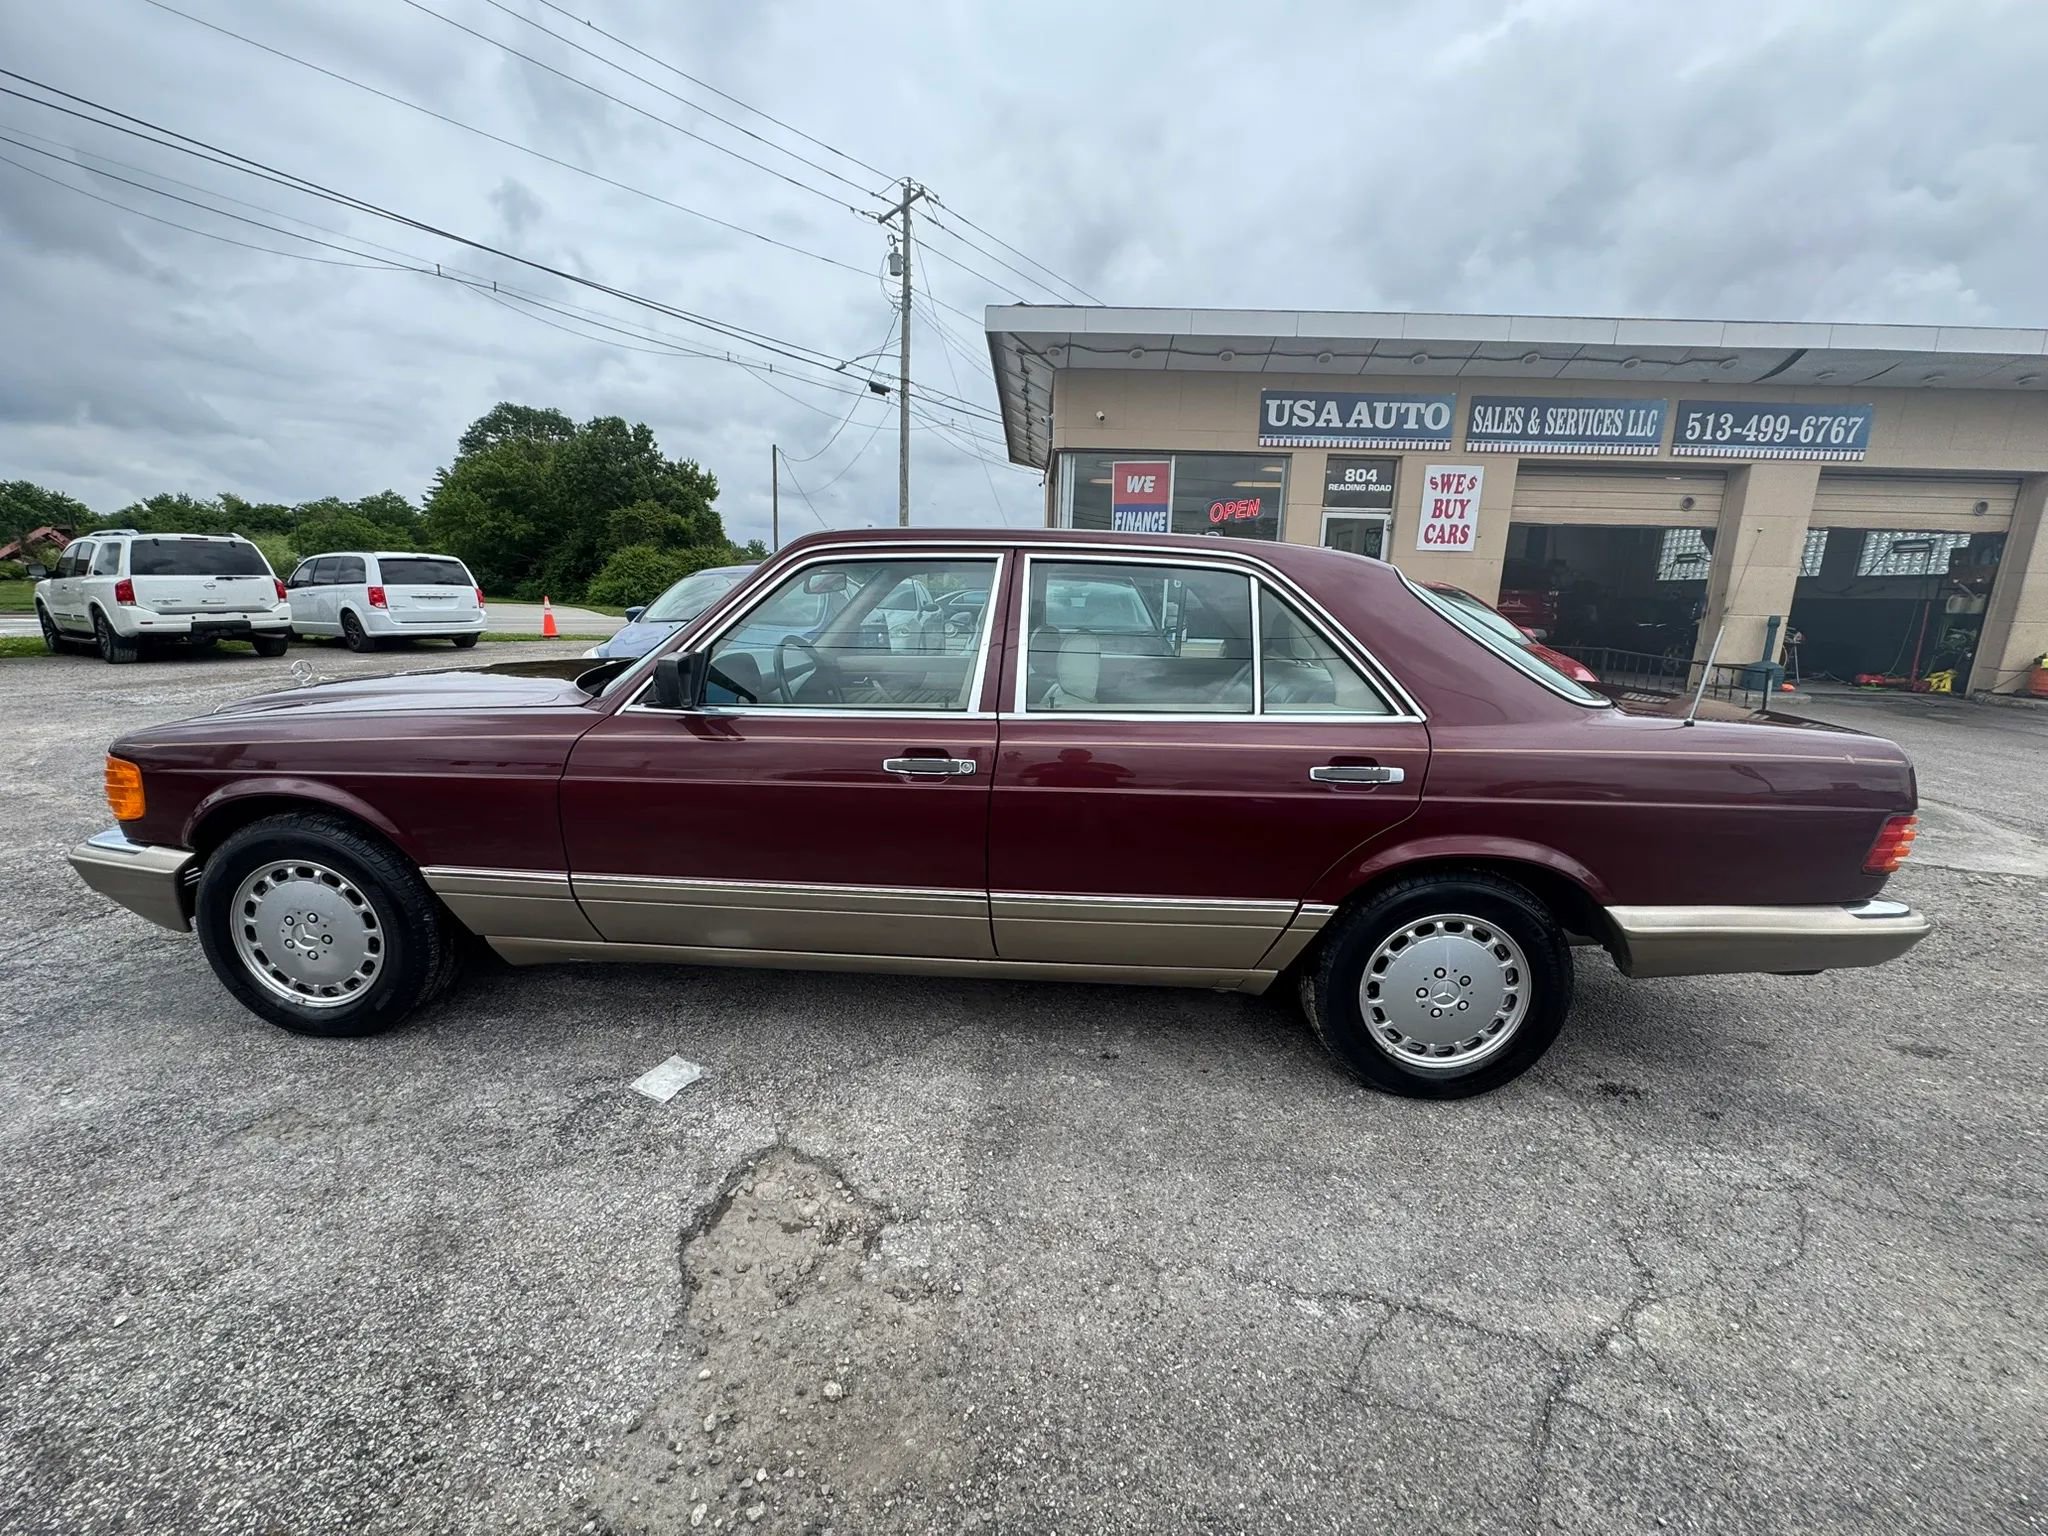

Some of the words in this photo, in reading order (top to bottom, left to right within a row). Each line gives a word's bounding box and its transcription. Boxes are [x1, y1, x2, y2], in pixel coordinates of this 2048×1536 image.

[1265, 399, 1343, 428] USA
[1345, 401, 1451, 431] AUTO
[1472, 405, 1525, 434] SALES
[1527, 407, 1541, 434] &
[1544, 407, 1624, 437] SERVICES
[1625, 409, 1658, 437] LLC
[1685, 412, 1865, 444] 513-499-6767
[1126, 475, 1156, 494] WE
[1344, 468, 1378, 483] 804
[1328, 483, 1367, 492] READING
[1367, 484, 1392, 492] ROAD
[1209, 498, 1261, 524] OPEN
[1431, 498, 1472, 520] BUY
[1114, 511, 1166, 533] FINANCE
[1423, 523, 1471, 545] CARS
